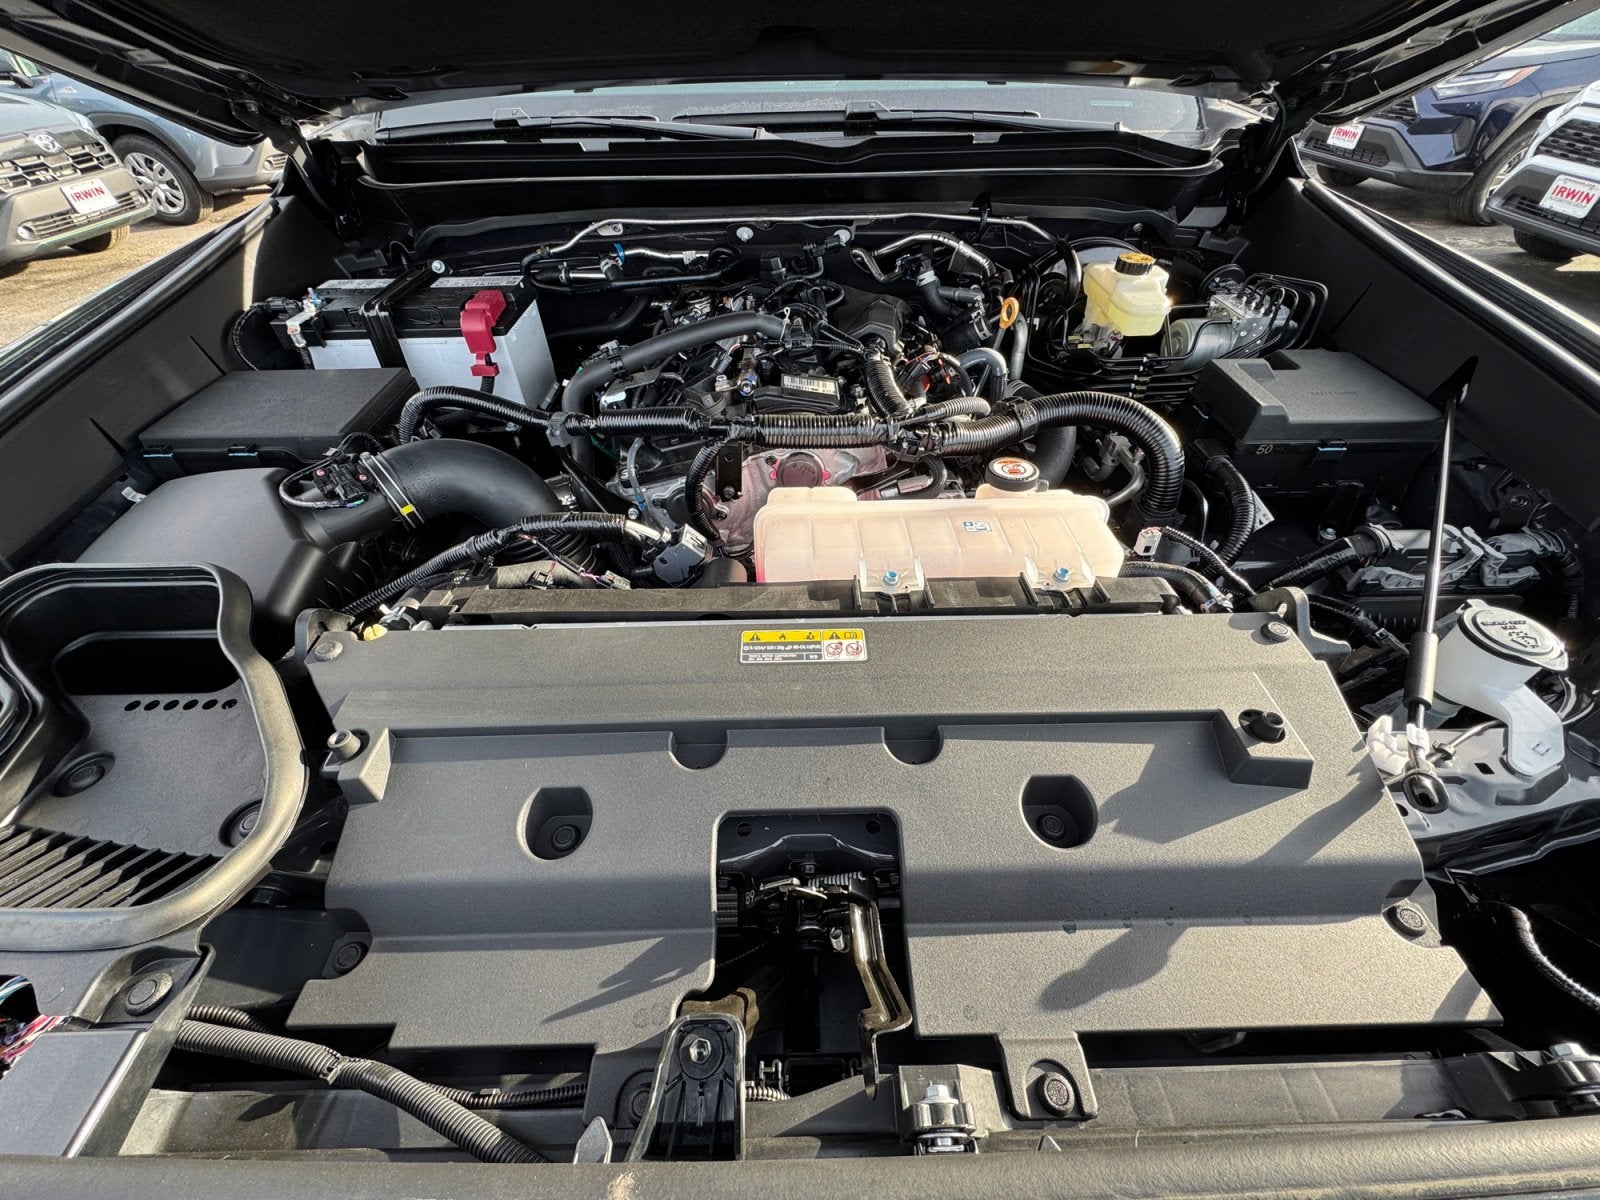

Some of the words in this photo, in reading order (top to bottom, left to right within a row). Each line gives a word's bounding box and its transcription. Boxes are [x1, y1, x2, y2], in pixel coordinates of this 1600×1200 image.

[1333, 127, 1359, 140] IRWIN
[70, 186, 105, 202] IRWIN
[1552, 184, 1596, 205] IRWIN
[1256, 444, 1274, 456] 50
